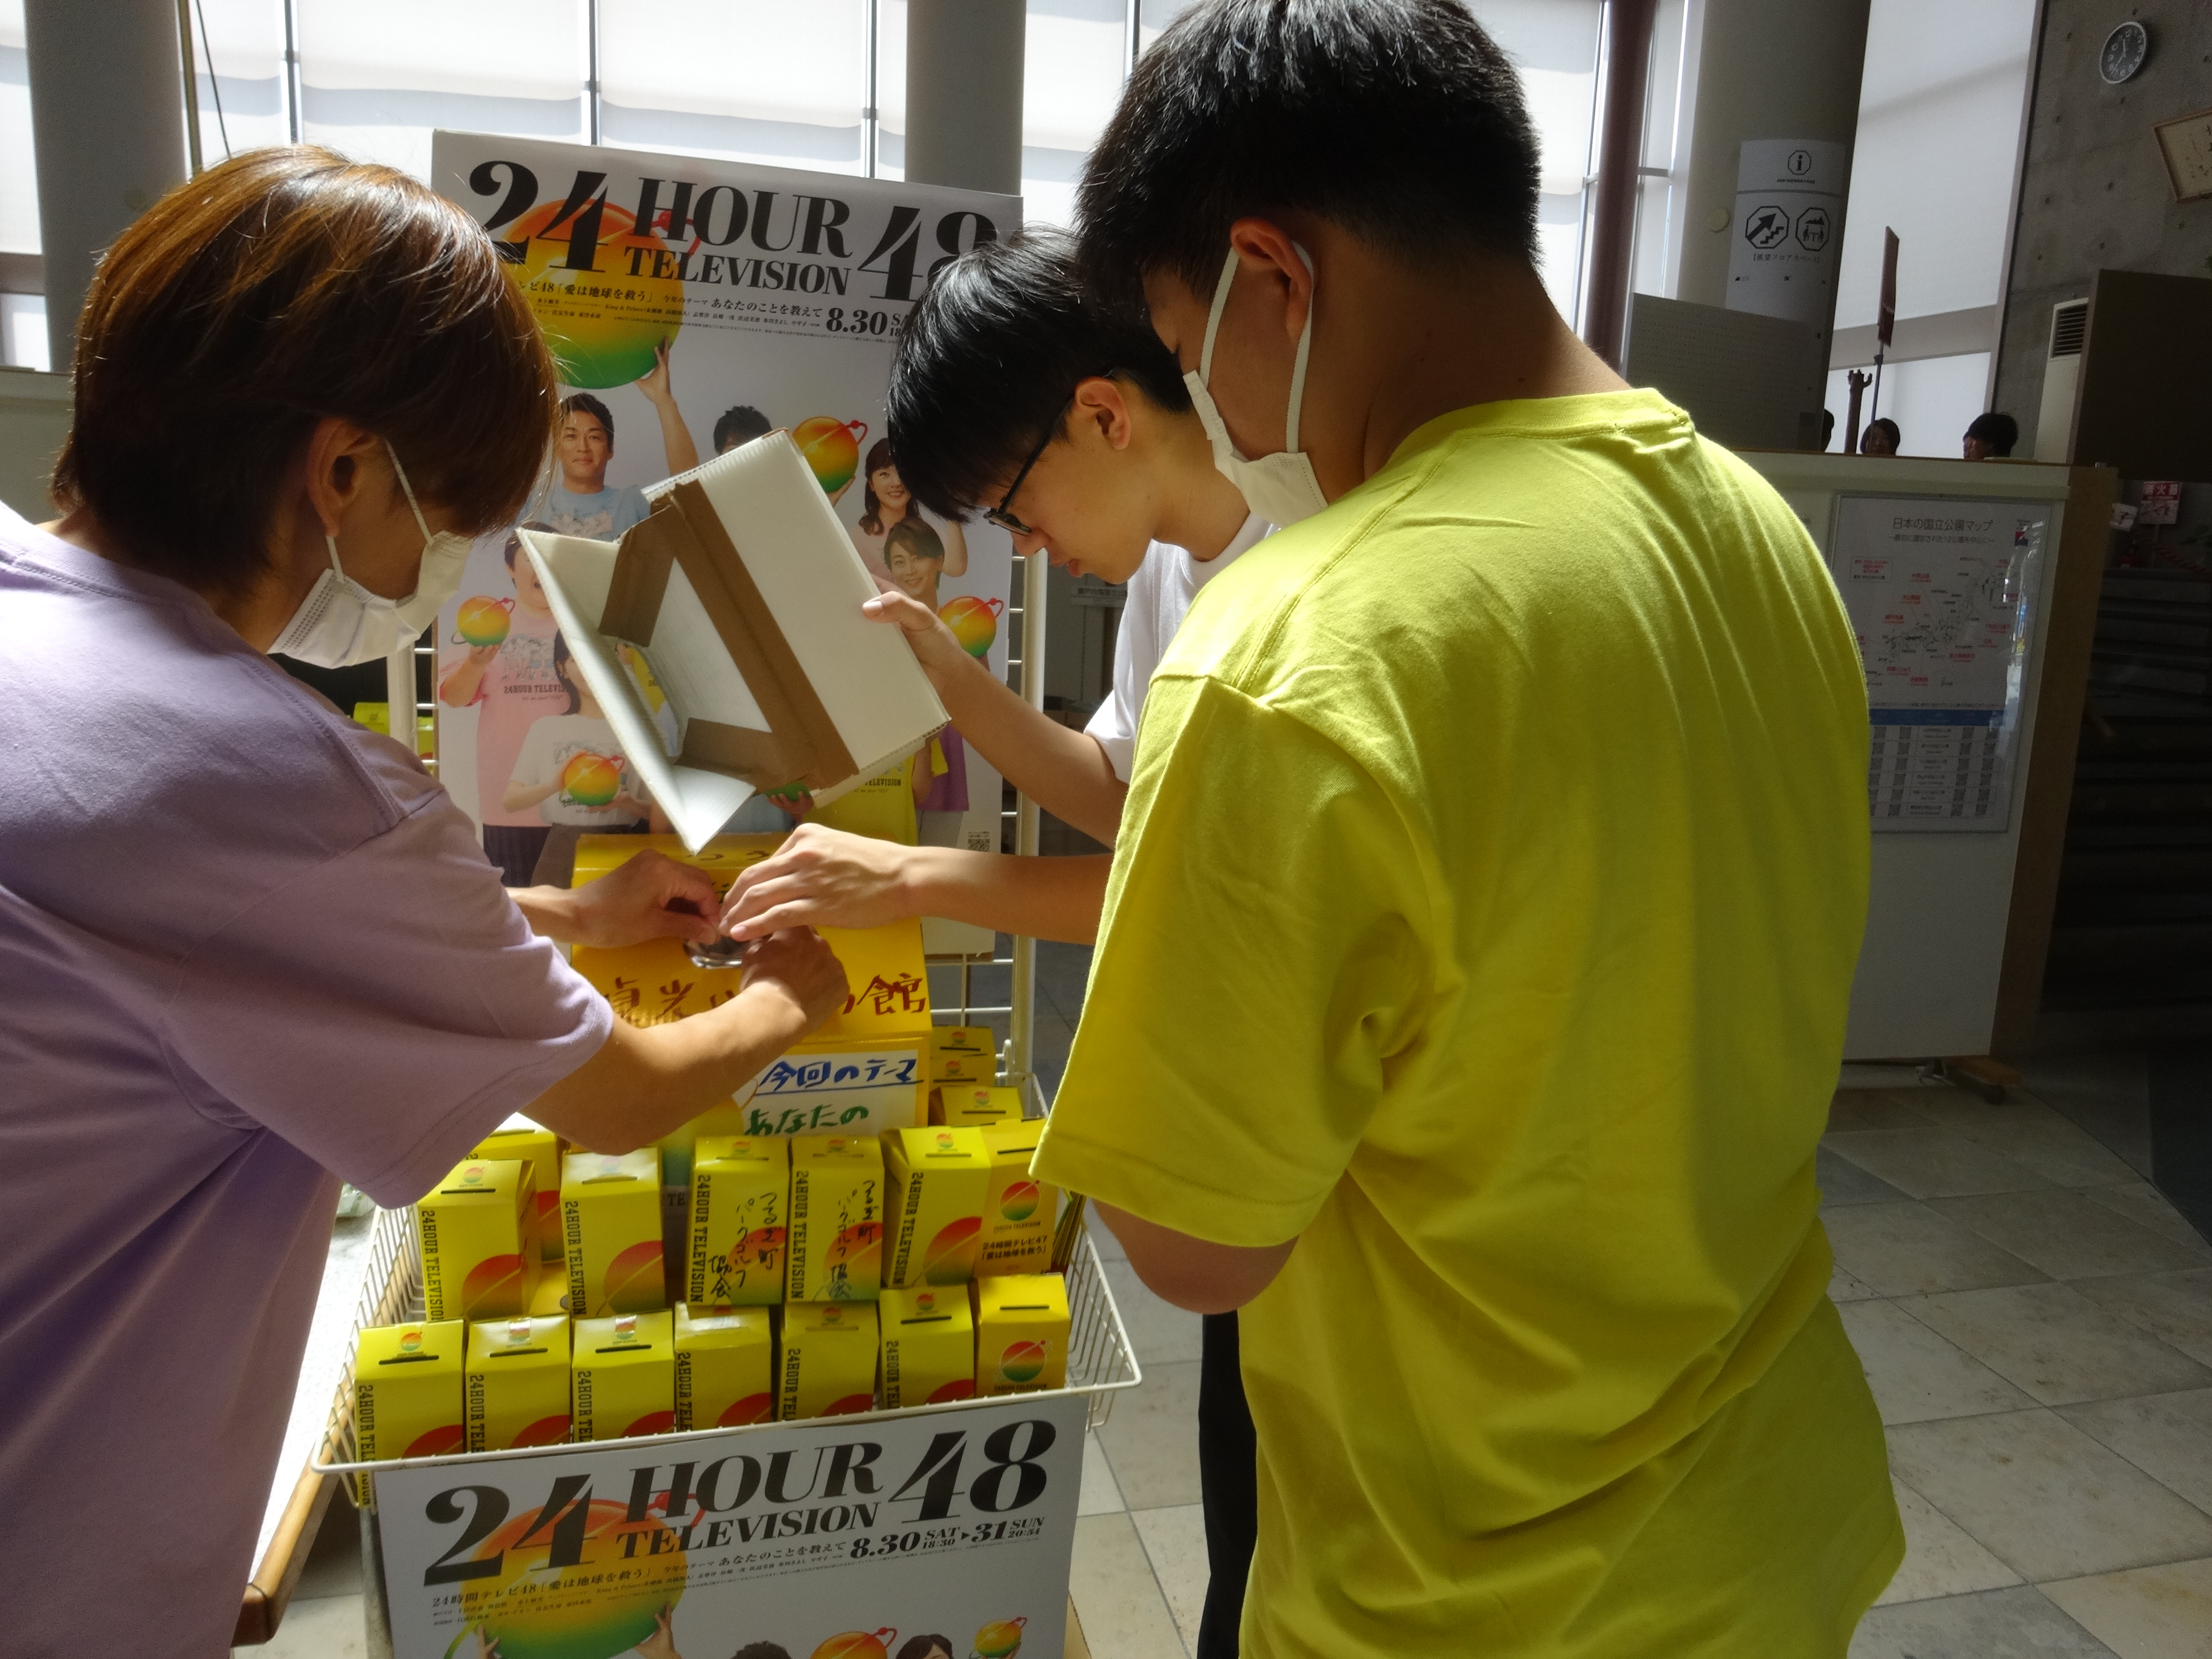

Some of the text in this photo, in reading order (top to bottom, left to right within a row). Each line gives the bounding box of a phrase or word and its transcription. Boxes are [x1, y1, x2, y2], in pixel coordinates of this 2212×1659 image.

[469, 161, 997, 301] 24 HOUR 48
[624, 246, 852, 297] TELEVISION
[711, 298, 823, 318] あなたのことを教えて
[826, 307, 888, 335] 8.30
[759, 1058, 917, 1091] 今回のテーマ
[745, 1104, 870, 1136] あなたの
[422, 1210, 438, 1254] 24HOUR
[691, 1175, 711, 1302] 24HOUR TELEVISION
[791, 1170, 809, 1299] 24HOUR TELEVISION
[565, 1201, 587, 1315] 24HOUR TELEVISION
[578, 1370, 592, 1416] 24HOUR
[678, 1352, 691, 1398] 24HOUR
[785, 1349, 800, 1393] 24HOUR
[358, 1384, 374, 1432] 24HOUR
[470, 1375, 484, 1421] 24HOUR
[424, 1419, 1057, 1586] 24 HOUR 48
[615, 1502, 879, 1559] TELEVISION
[850, 1517, 1045, 1559] 8.30 SAT 31 SUN
[922, 1538, 956, 1549] 18:30
[1008, 1527, 1041, 1538] 20:54
[719, 1541, 847, 1567] あなたのことを教えて
